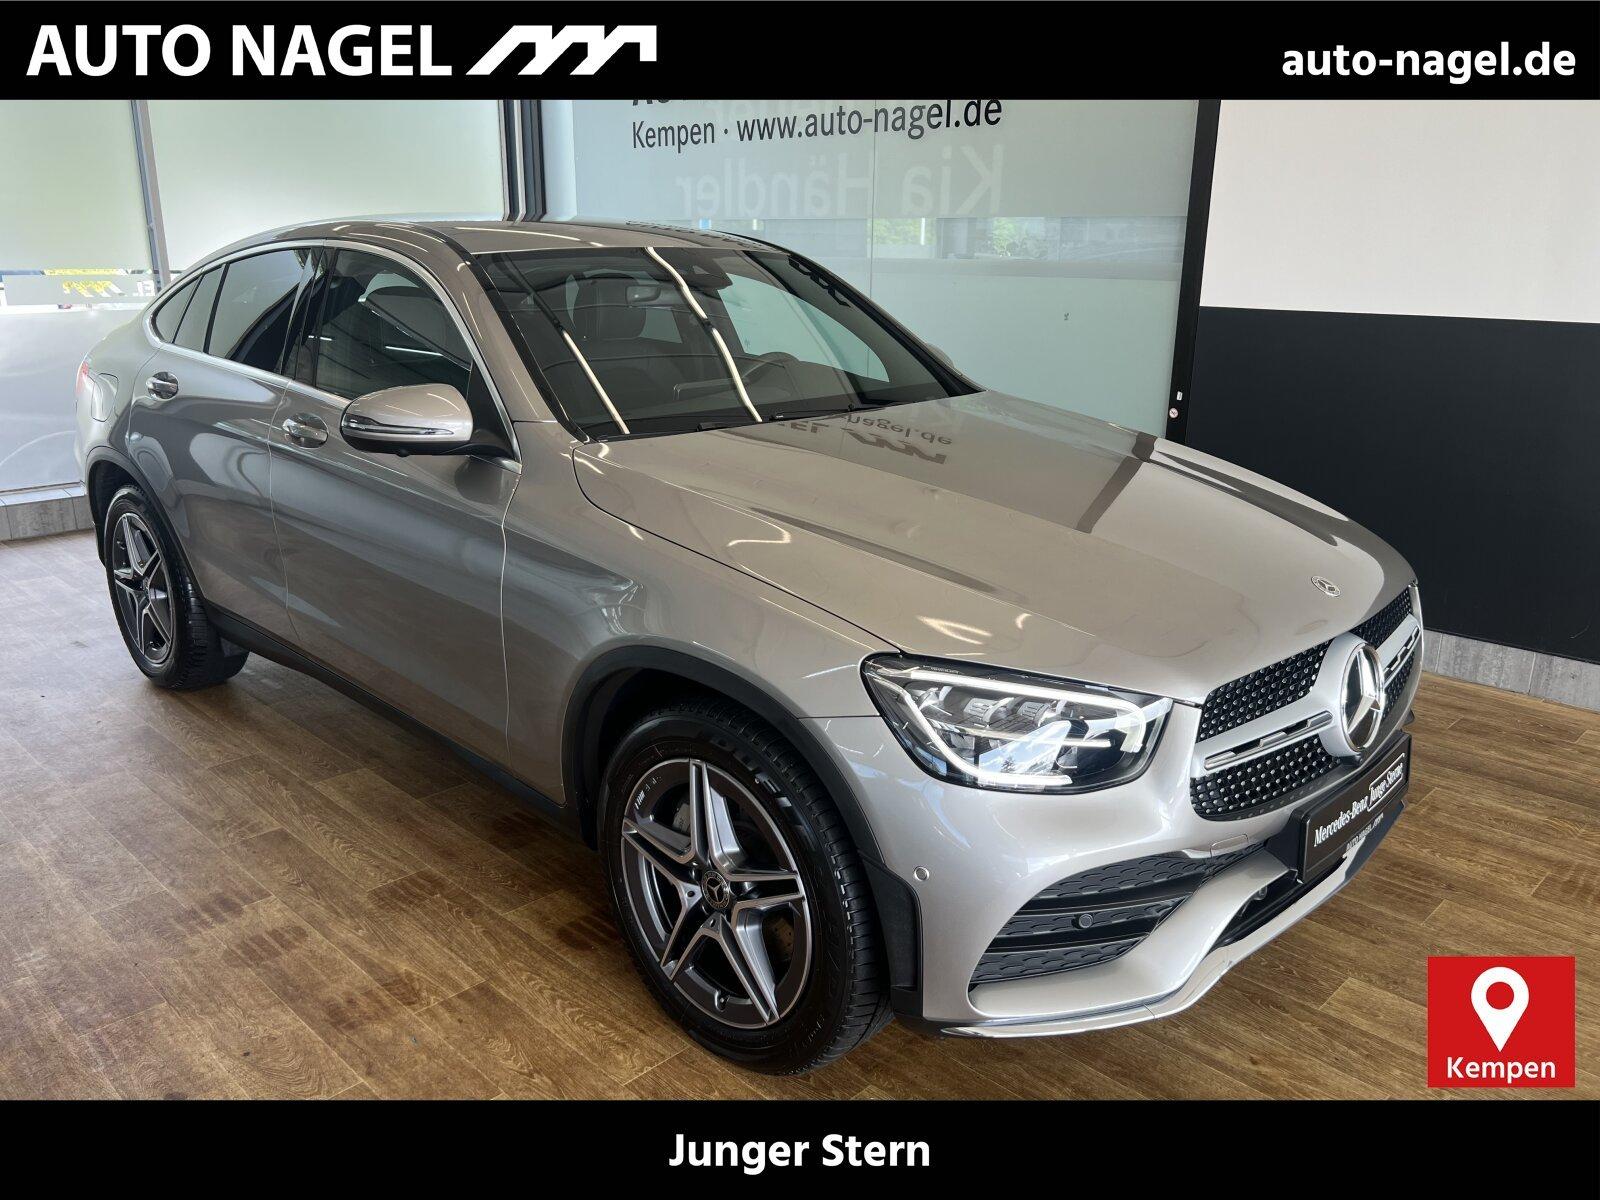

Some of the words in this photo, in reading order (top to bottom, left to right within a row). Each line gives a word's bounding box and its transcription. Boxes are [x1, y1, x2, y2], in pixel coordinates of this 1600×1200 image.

[632, 120, 715, 154] Kempen
[737, 98, 1003, 142] www.auto-nagel.de
[1313, 795, 1368, 848] Mercedes-Benz
